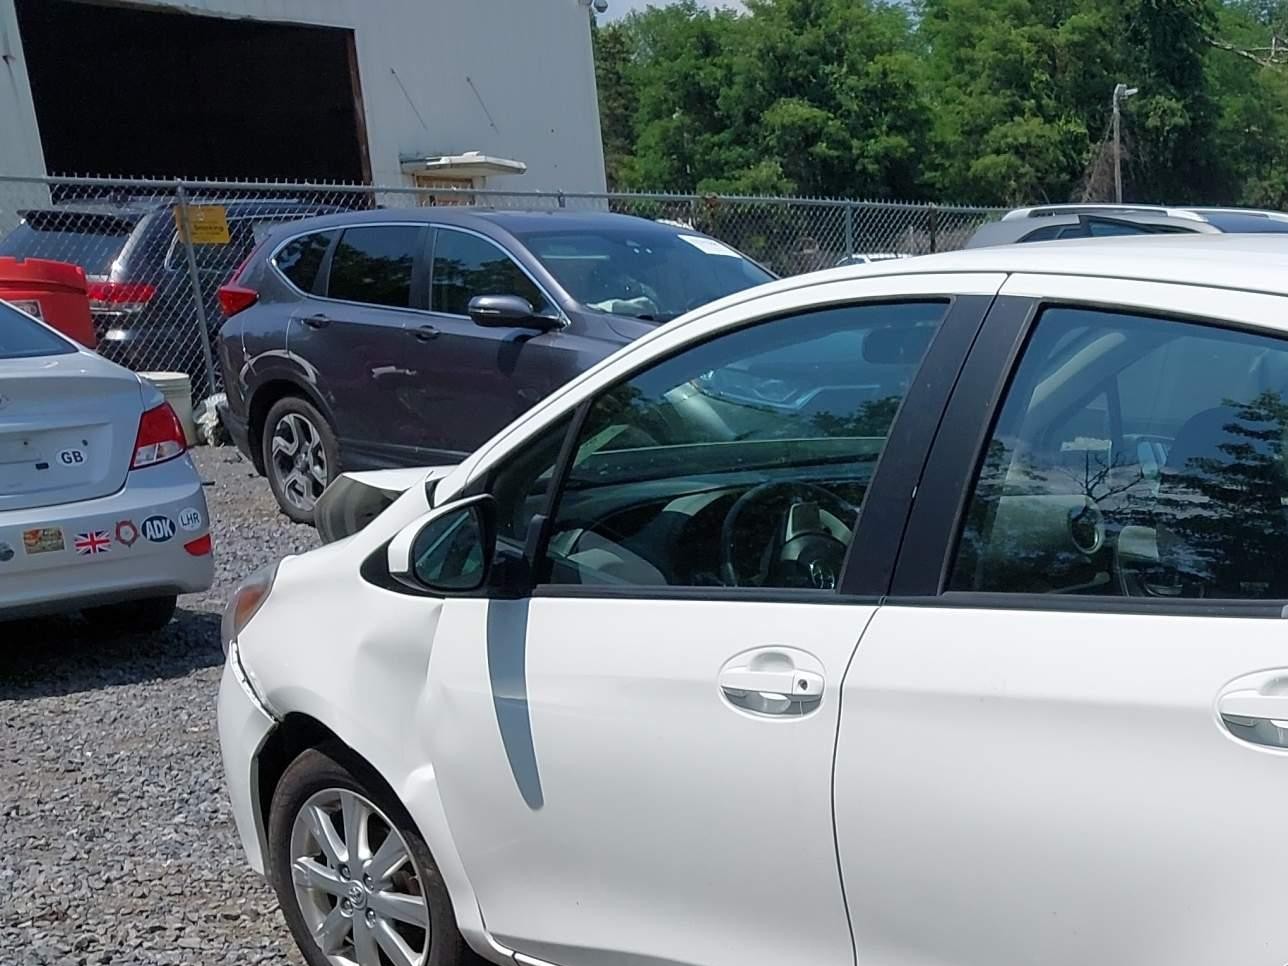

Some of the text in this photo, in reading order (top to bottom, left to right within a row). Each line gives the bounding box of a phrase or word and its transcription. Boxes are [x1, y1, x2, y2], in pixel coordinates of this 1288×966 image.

[61, 450, 83, 464] GB
[180, 512, 200, 527] LHR
[145, 520, 174, 541] ADK
